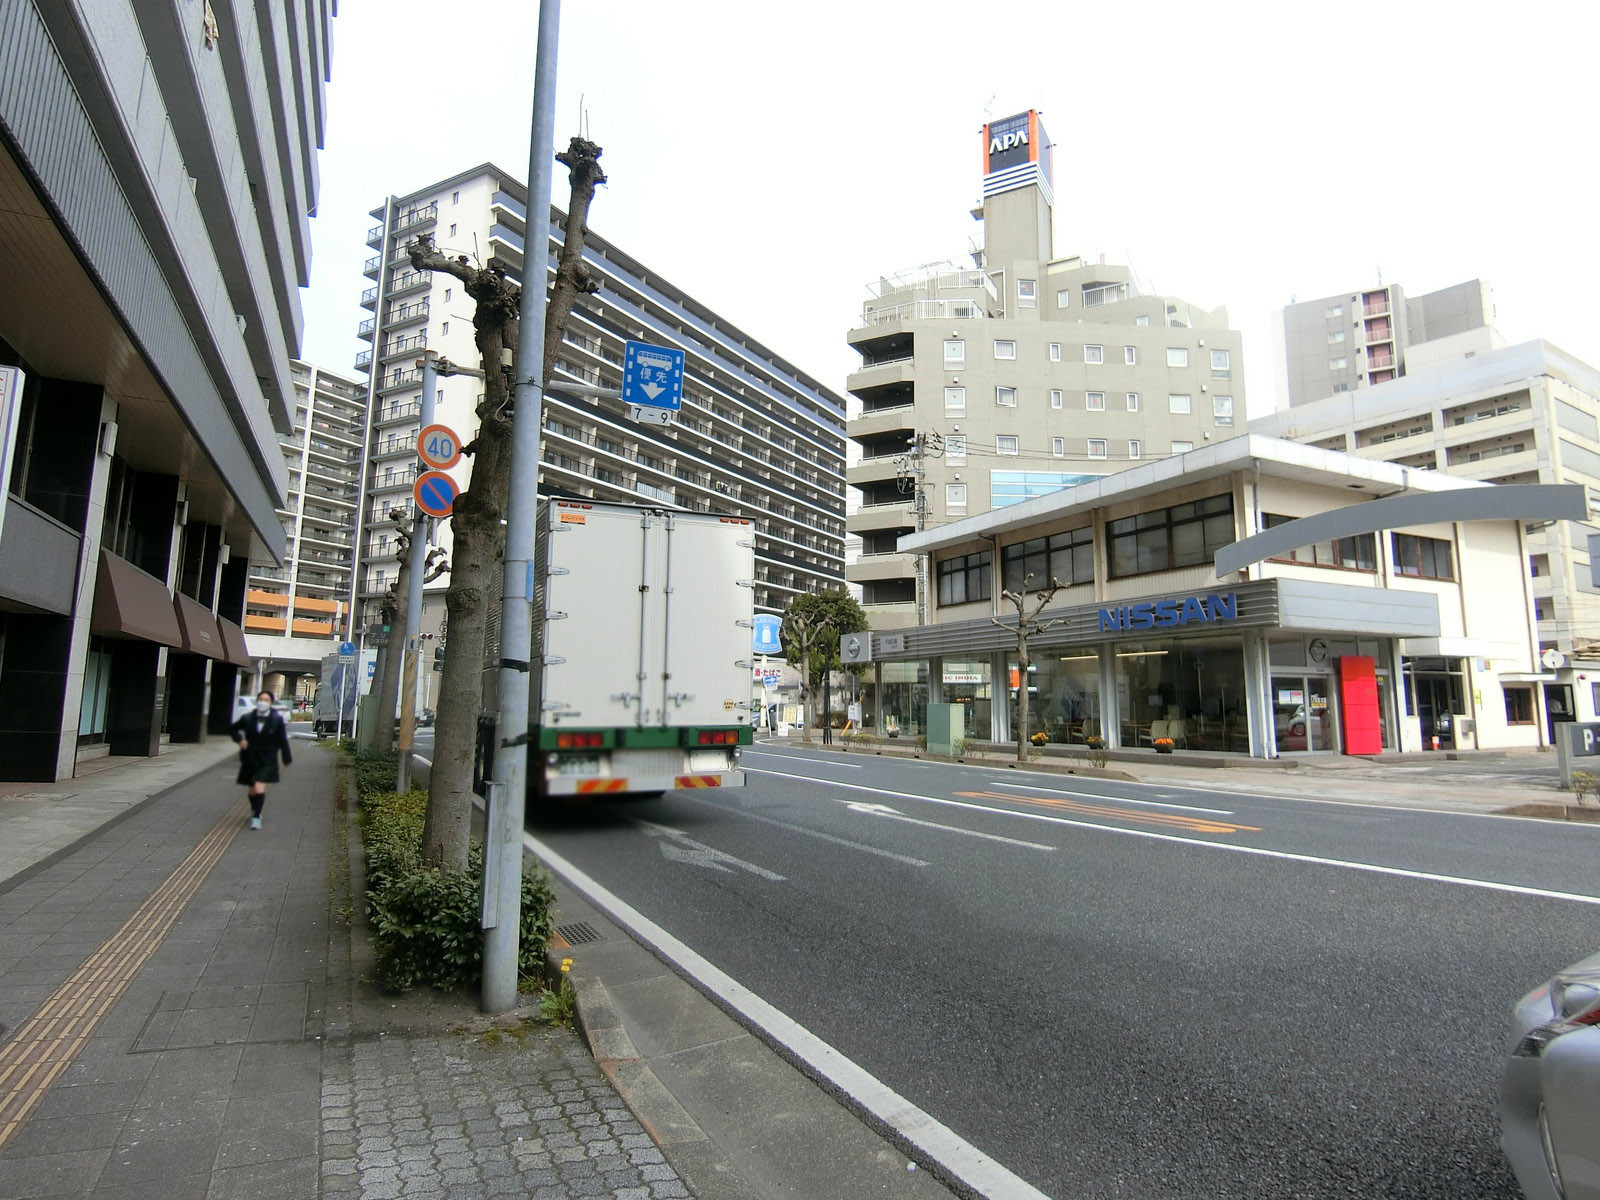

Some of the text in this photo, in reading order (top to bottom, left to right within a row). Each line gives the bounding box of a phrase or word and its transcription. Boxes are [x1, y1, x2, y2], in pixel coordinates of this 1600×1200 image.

[989, 129, 1028, 155] APA
[640, 368, 667, 383] 優先
[427, 437, 452, 458] 40
[1097, 592, 1237, 632] NISSAN
[1583, 728, 1594, 751] P
